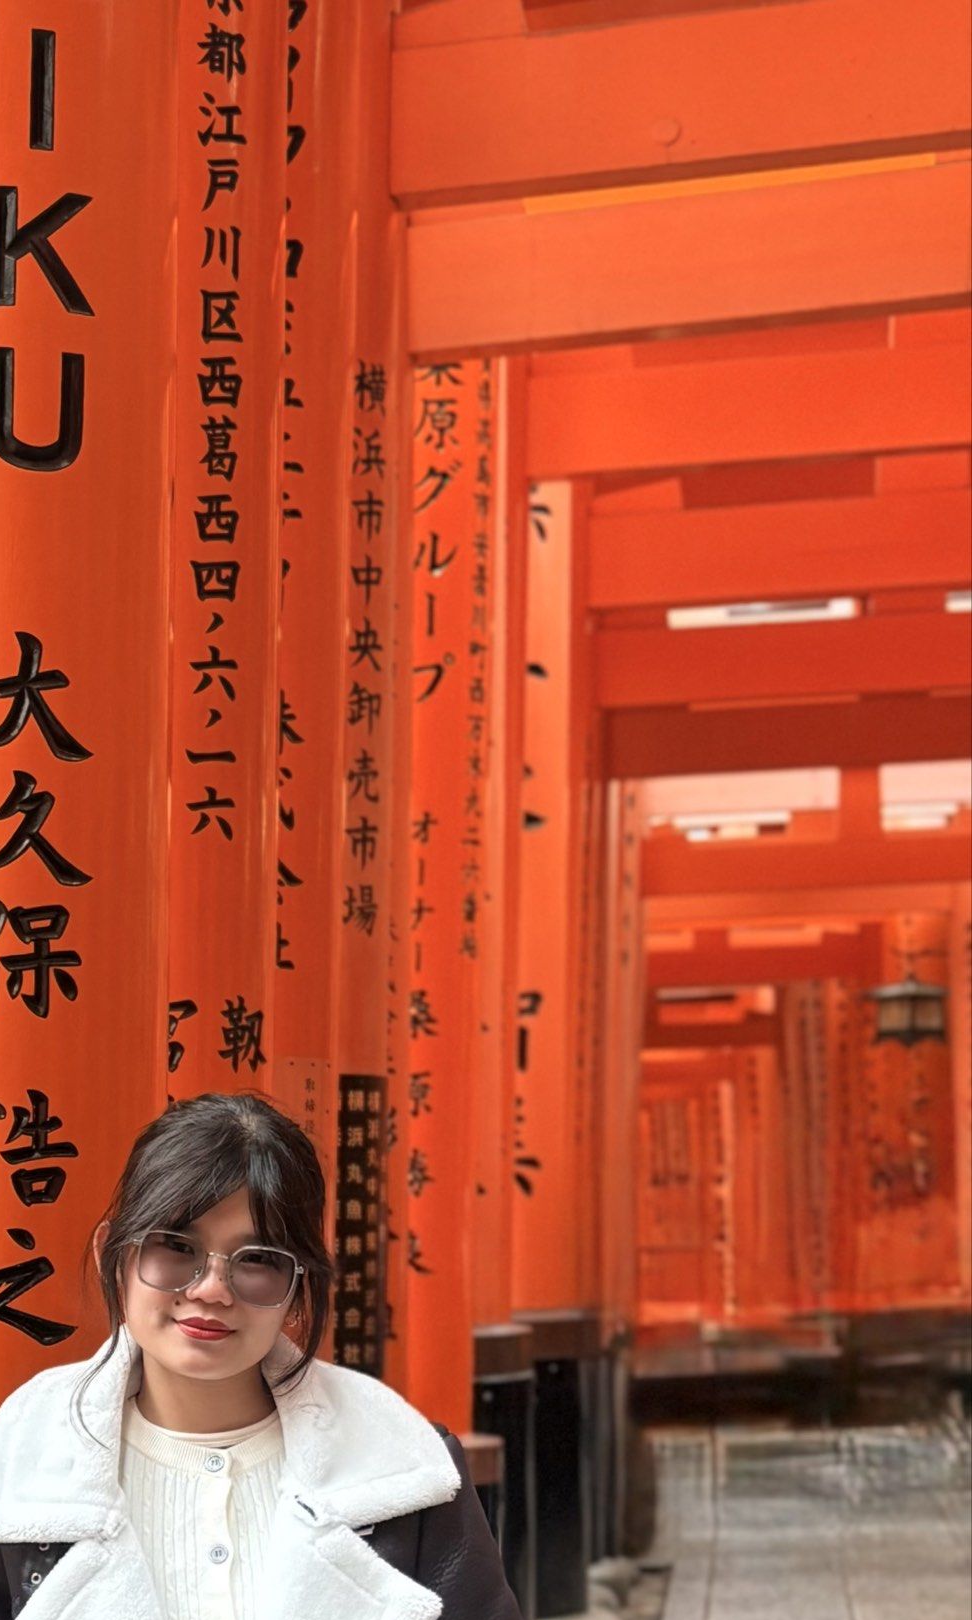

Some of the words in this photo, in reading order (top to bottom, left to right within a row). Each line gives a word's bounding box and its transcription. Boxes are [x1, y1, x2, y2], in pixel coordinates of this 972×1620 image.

[343, 359, 387, 937] 横浜市中央卸売市場
